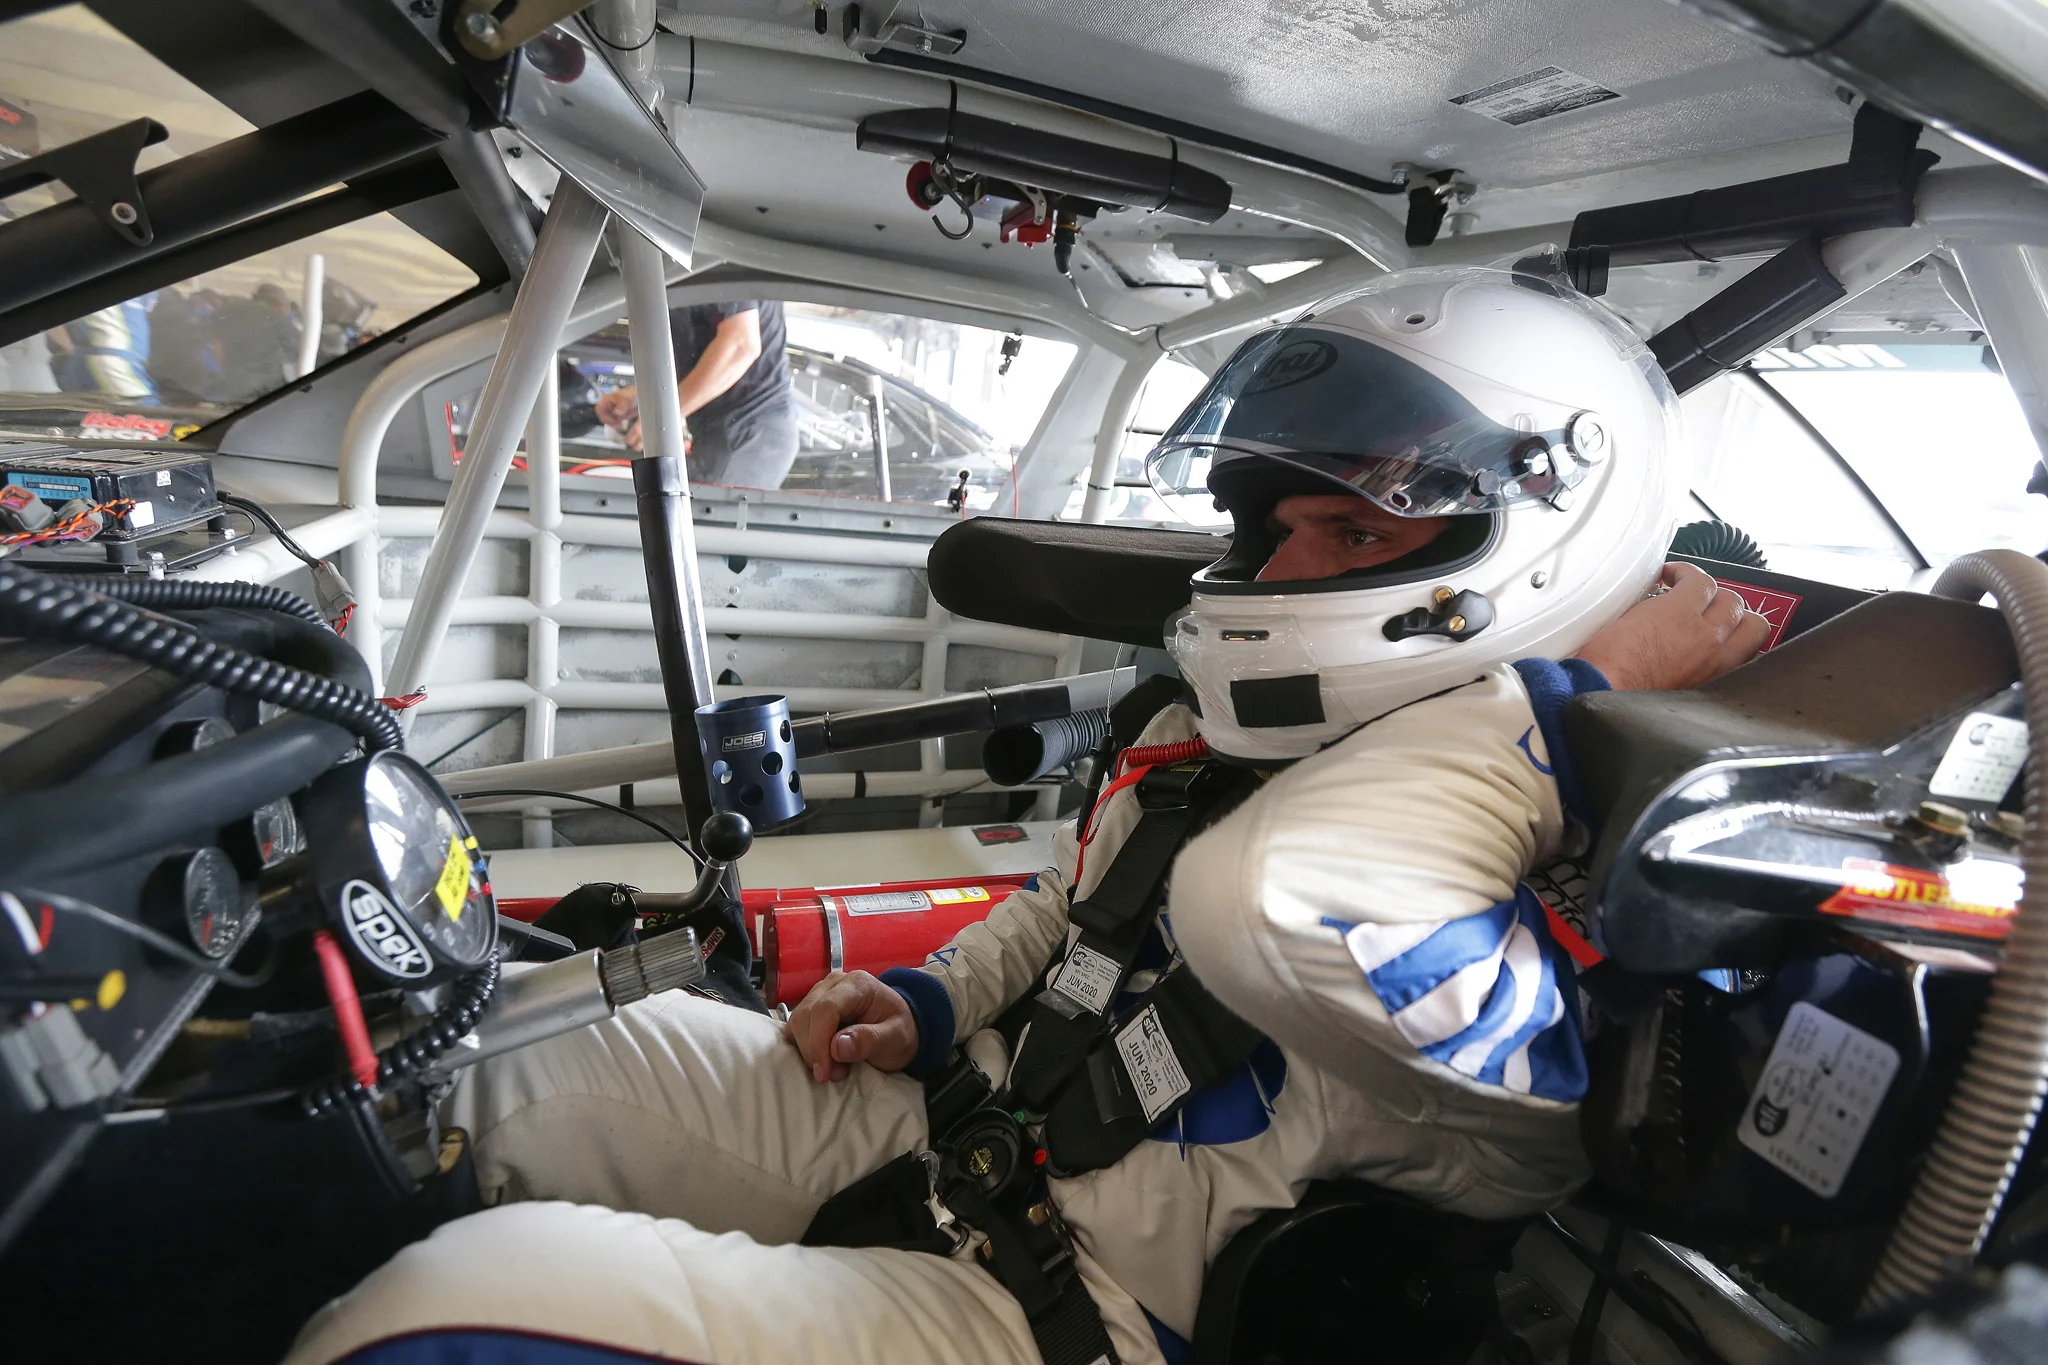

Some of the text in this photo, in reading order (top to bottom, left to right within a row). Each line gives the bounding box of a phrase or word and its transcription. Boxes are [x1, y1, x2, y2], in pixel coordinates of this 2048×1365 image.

[80, 411, 172, 437] Holley
[725, 733, 764, 746] JOES
[1073, 953, 1085, 964] sfi
[1066, 974, 1083, 990] JUN
[1080, 982, 1098, 999] 2020
[1143, 1018, 1156, 1034] sfi
[1128, 1041, 1145, 1067] JUN
[1140, 1066, 1158, 1096] 2020
